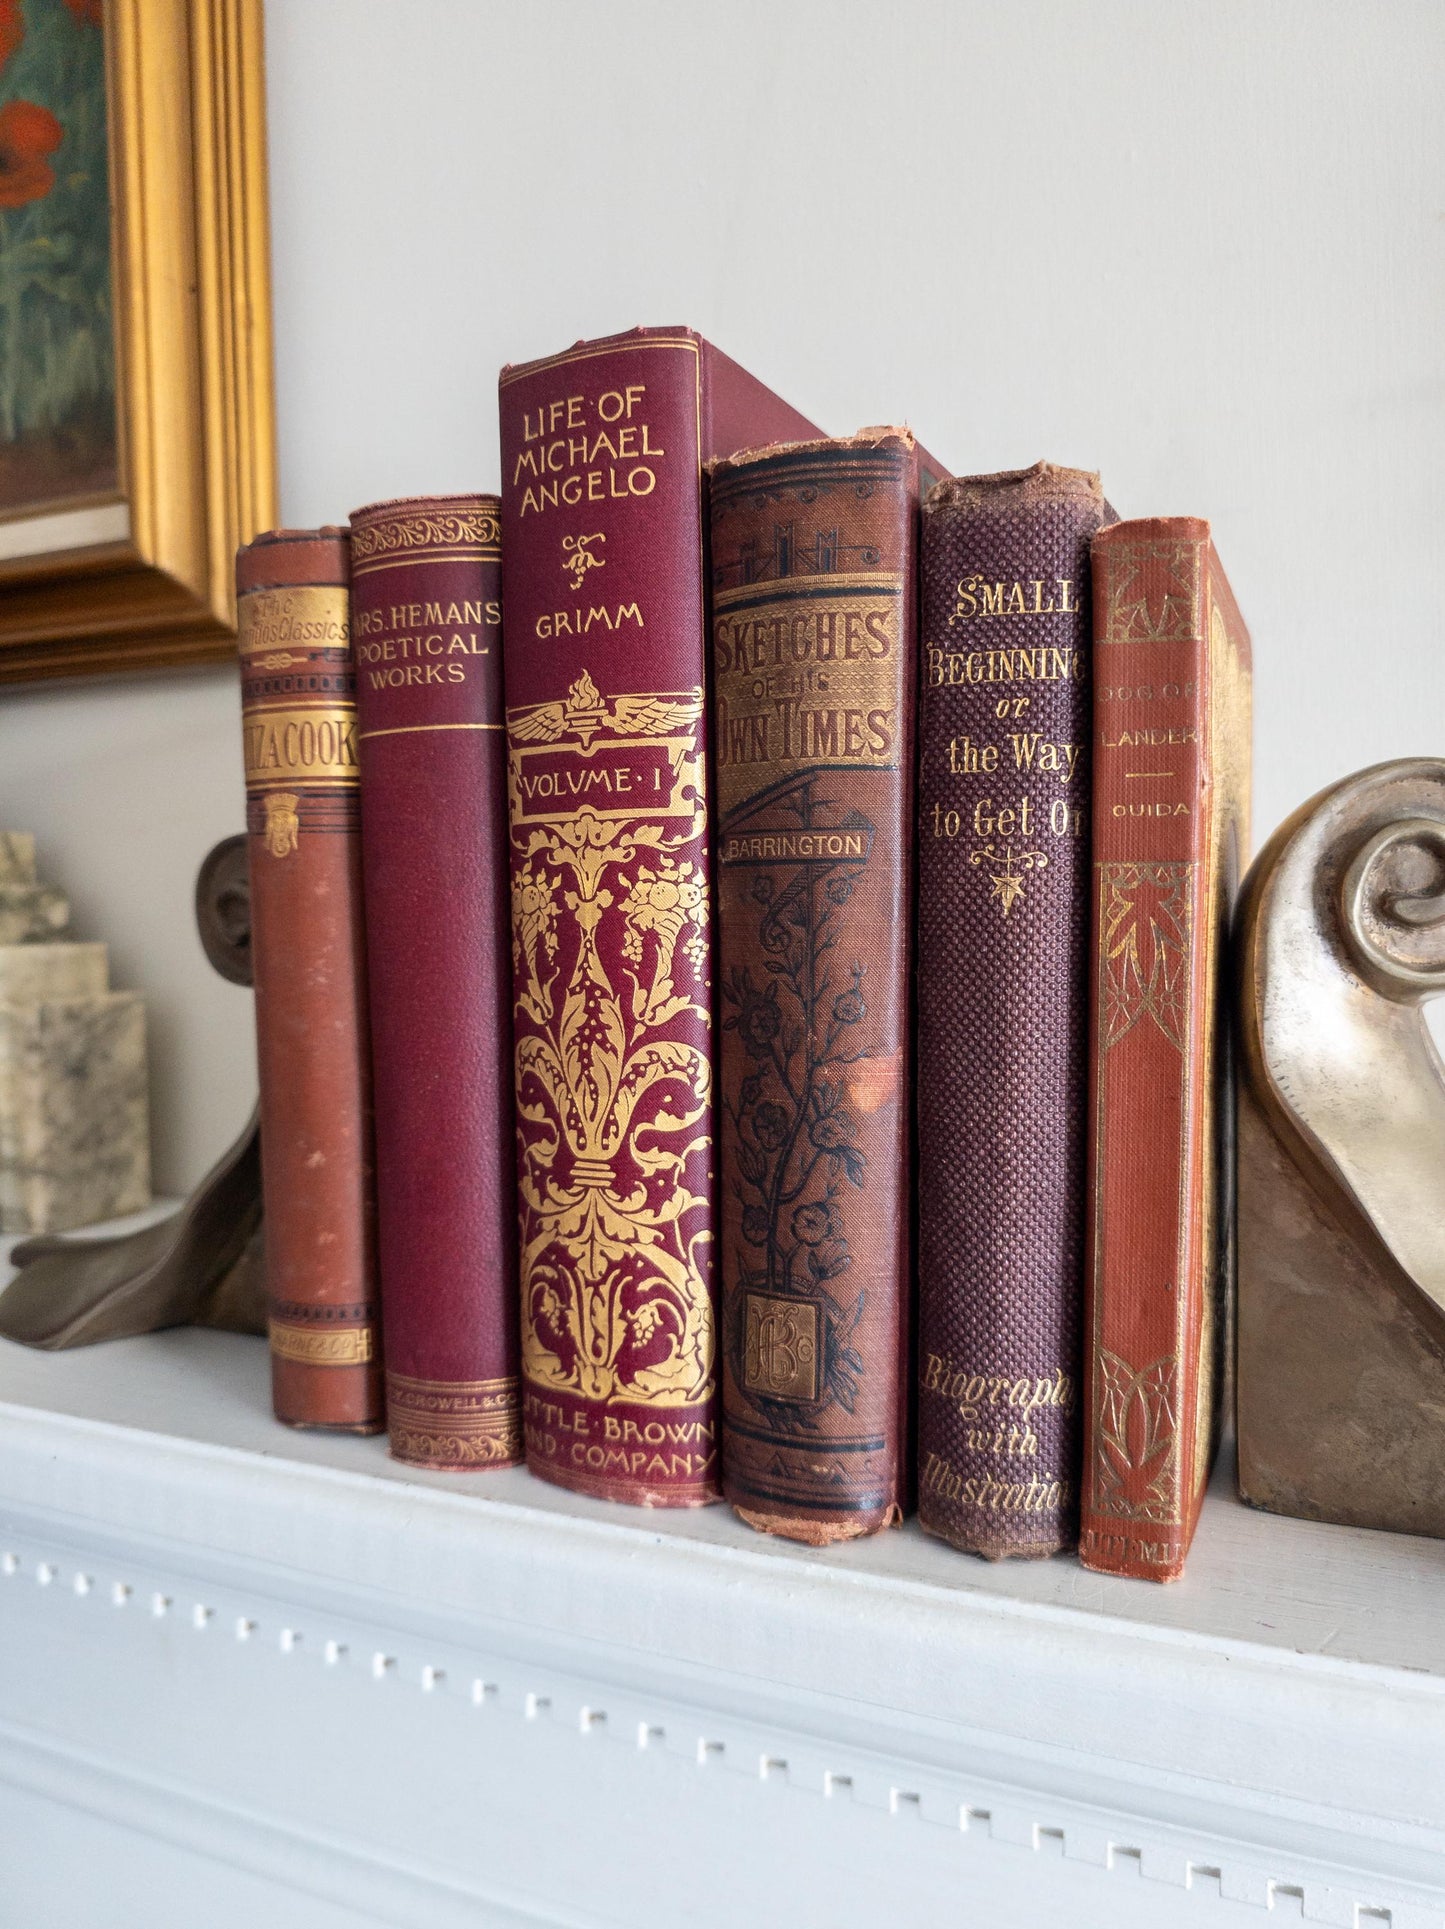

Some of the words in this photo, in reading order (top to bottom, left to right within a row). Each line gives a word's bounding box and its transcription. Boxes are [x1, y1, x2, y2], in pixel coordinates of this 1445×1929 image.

[523, 396, 587, 442] LIFE
[598, 385, 647, 422] OF
[513, 424, 665, 486] MICHAEL
[520, 466, 657, 517] ANGELO
[390, 600, 502, 630] HEMANS
[948, 574, 1080, 625] SMALL
[536, 602, 645, 638] GRIMM
[358, 633, 489, 665] POETICAL
[715, 610, 892, 676] SKETCHES
[369, 663, 466, 690] WORKS
[996, 696, 1030, 718] or
[284, 720, 358, 768] COOK
[774, 697, 896, 760] TIMES
[945, 735, 999, 774] the
[1006, 733, 1083, 783] Way
[930, 801, 961, 837] to
[974, 796, 1035, 837] Get
[1112, 802, 1191, 818] OUIDA
[729, 835, 862, 859] BARRINGTON
[604, 1415, 715, 1444] BROWN
[968, 1422, 1038, 1455] with
[571, 1442, 717, 1476] COMPANY
